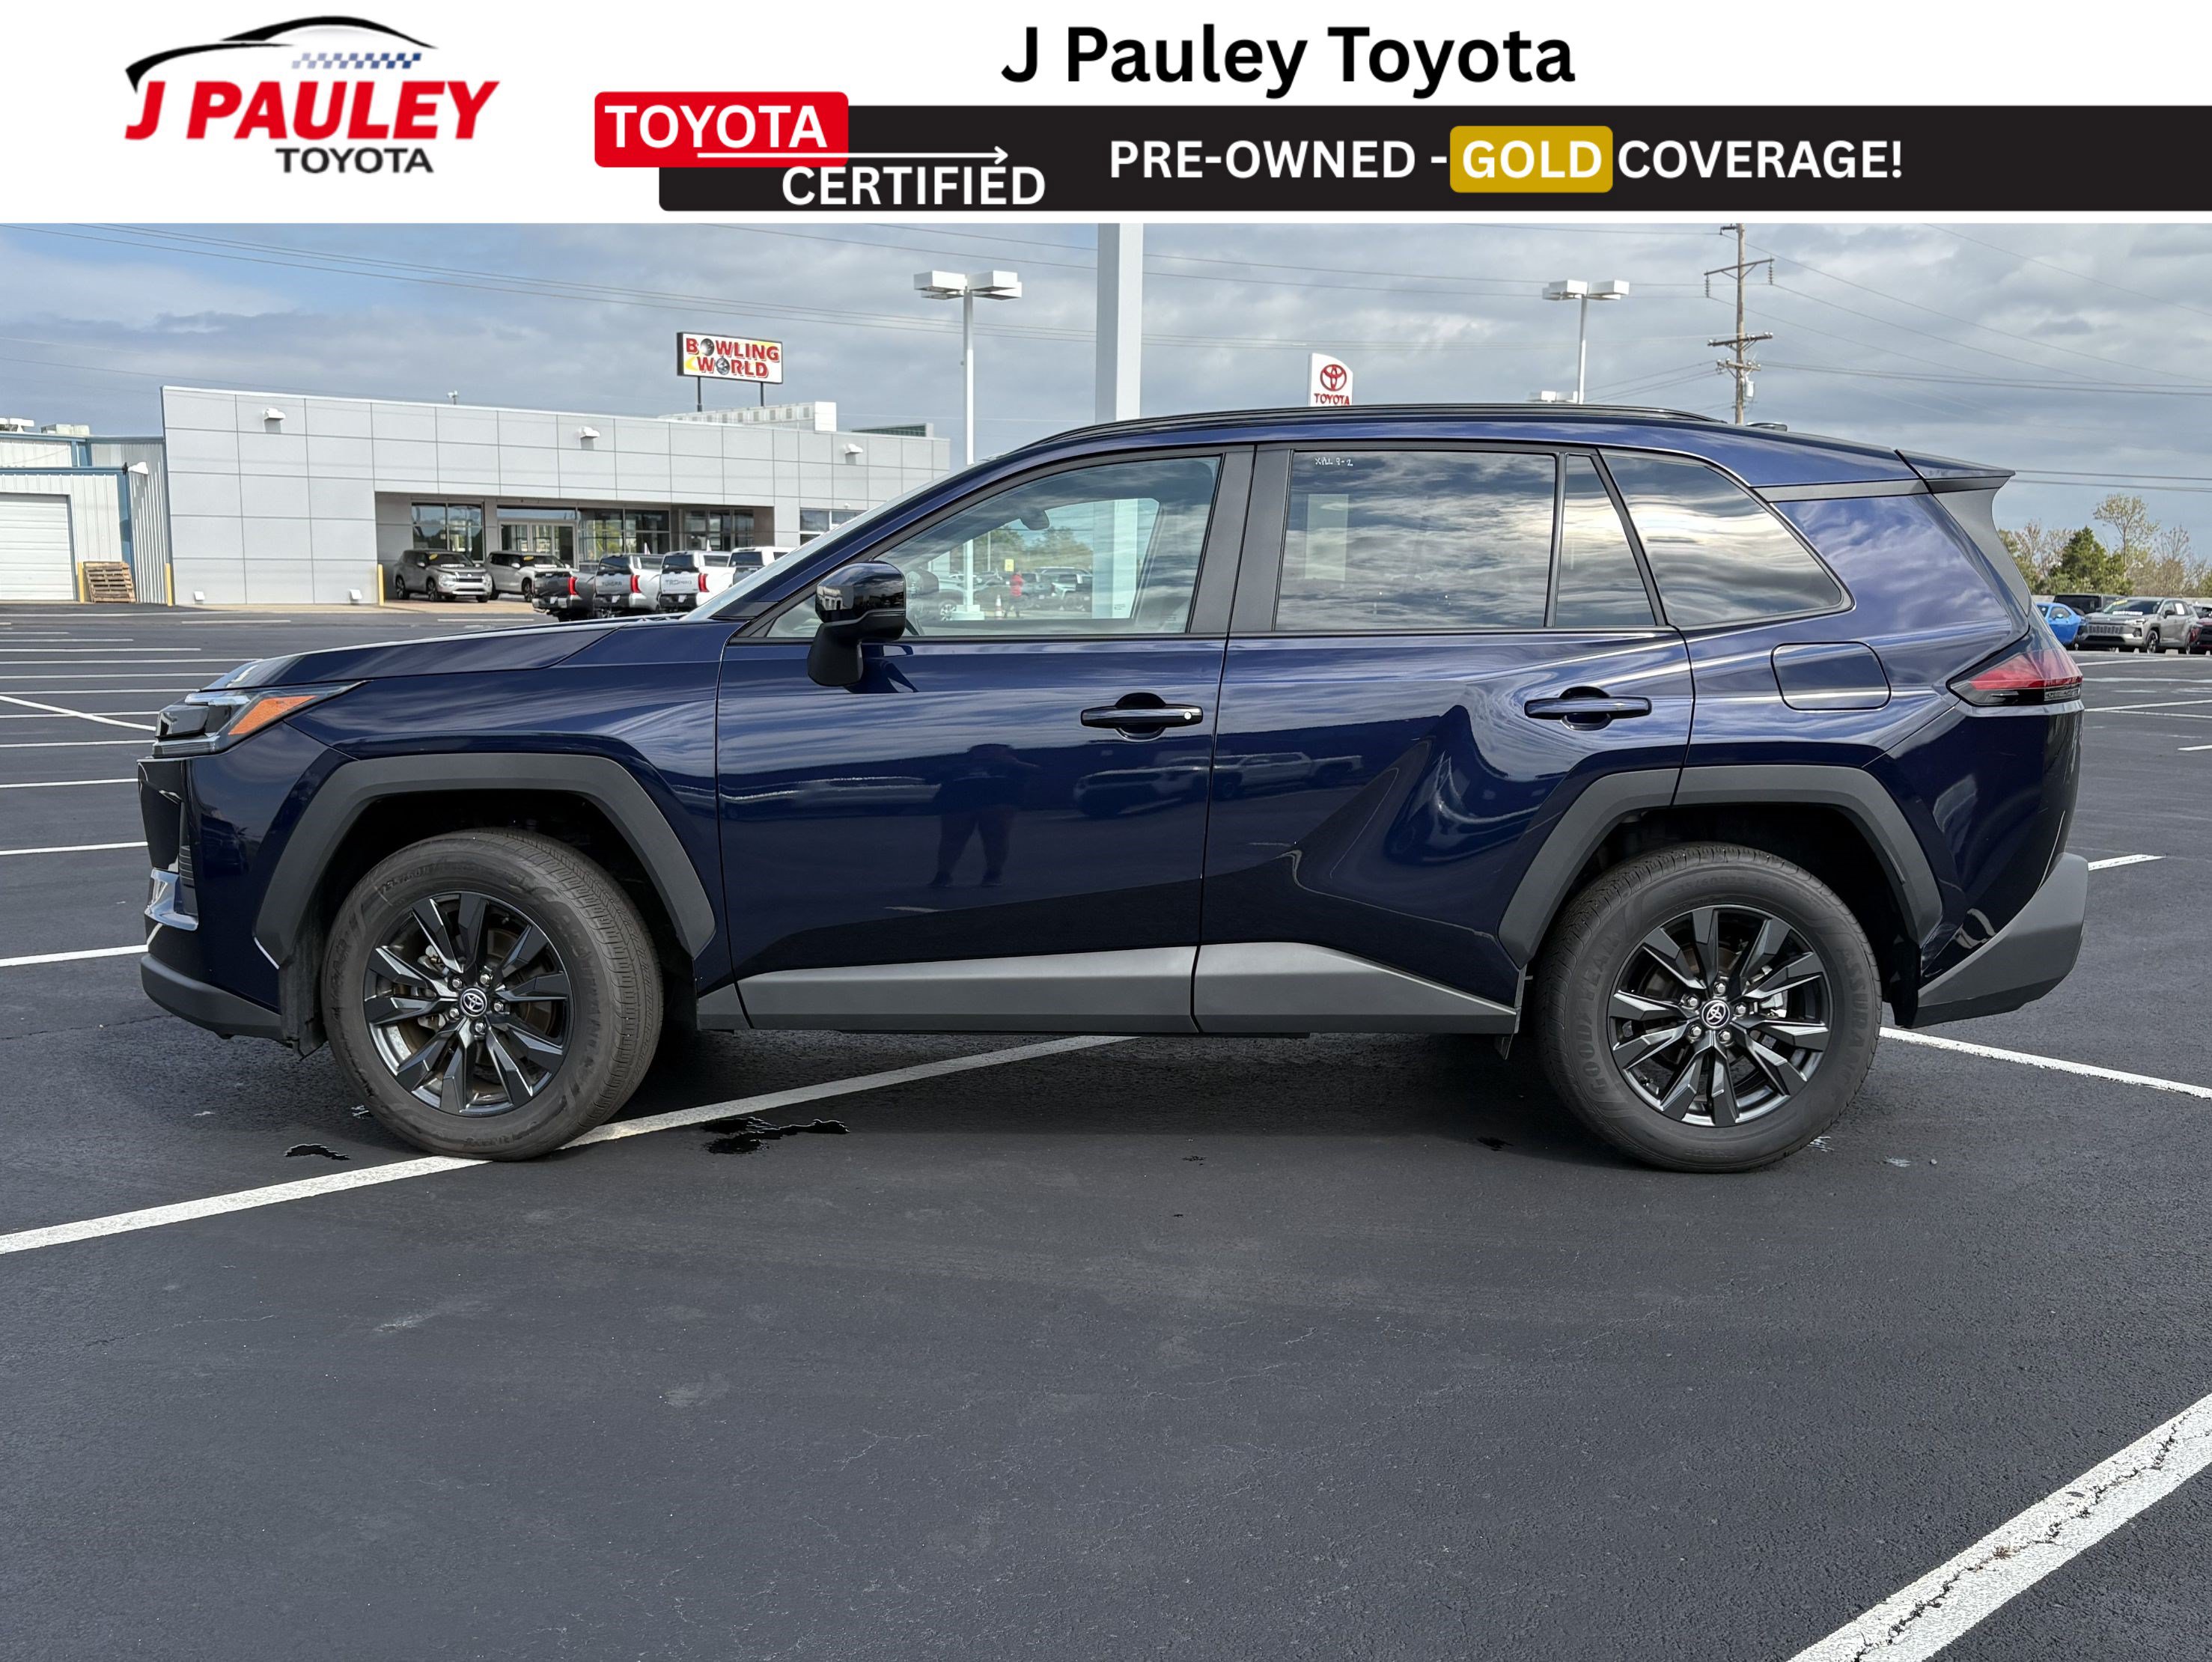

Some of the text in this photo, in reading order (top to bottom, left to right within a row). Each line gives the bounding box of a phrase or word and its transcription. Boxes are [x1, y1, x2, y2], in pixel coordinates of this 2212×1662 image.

[686, 338, 780, 362] BOWLING
[696, 356, 769, 377] WORLD
[1314, 393, 1350, 406] TOYOTA
